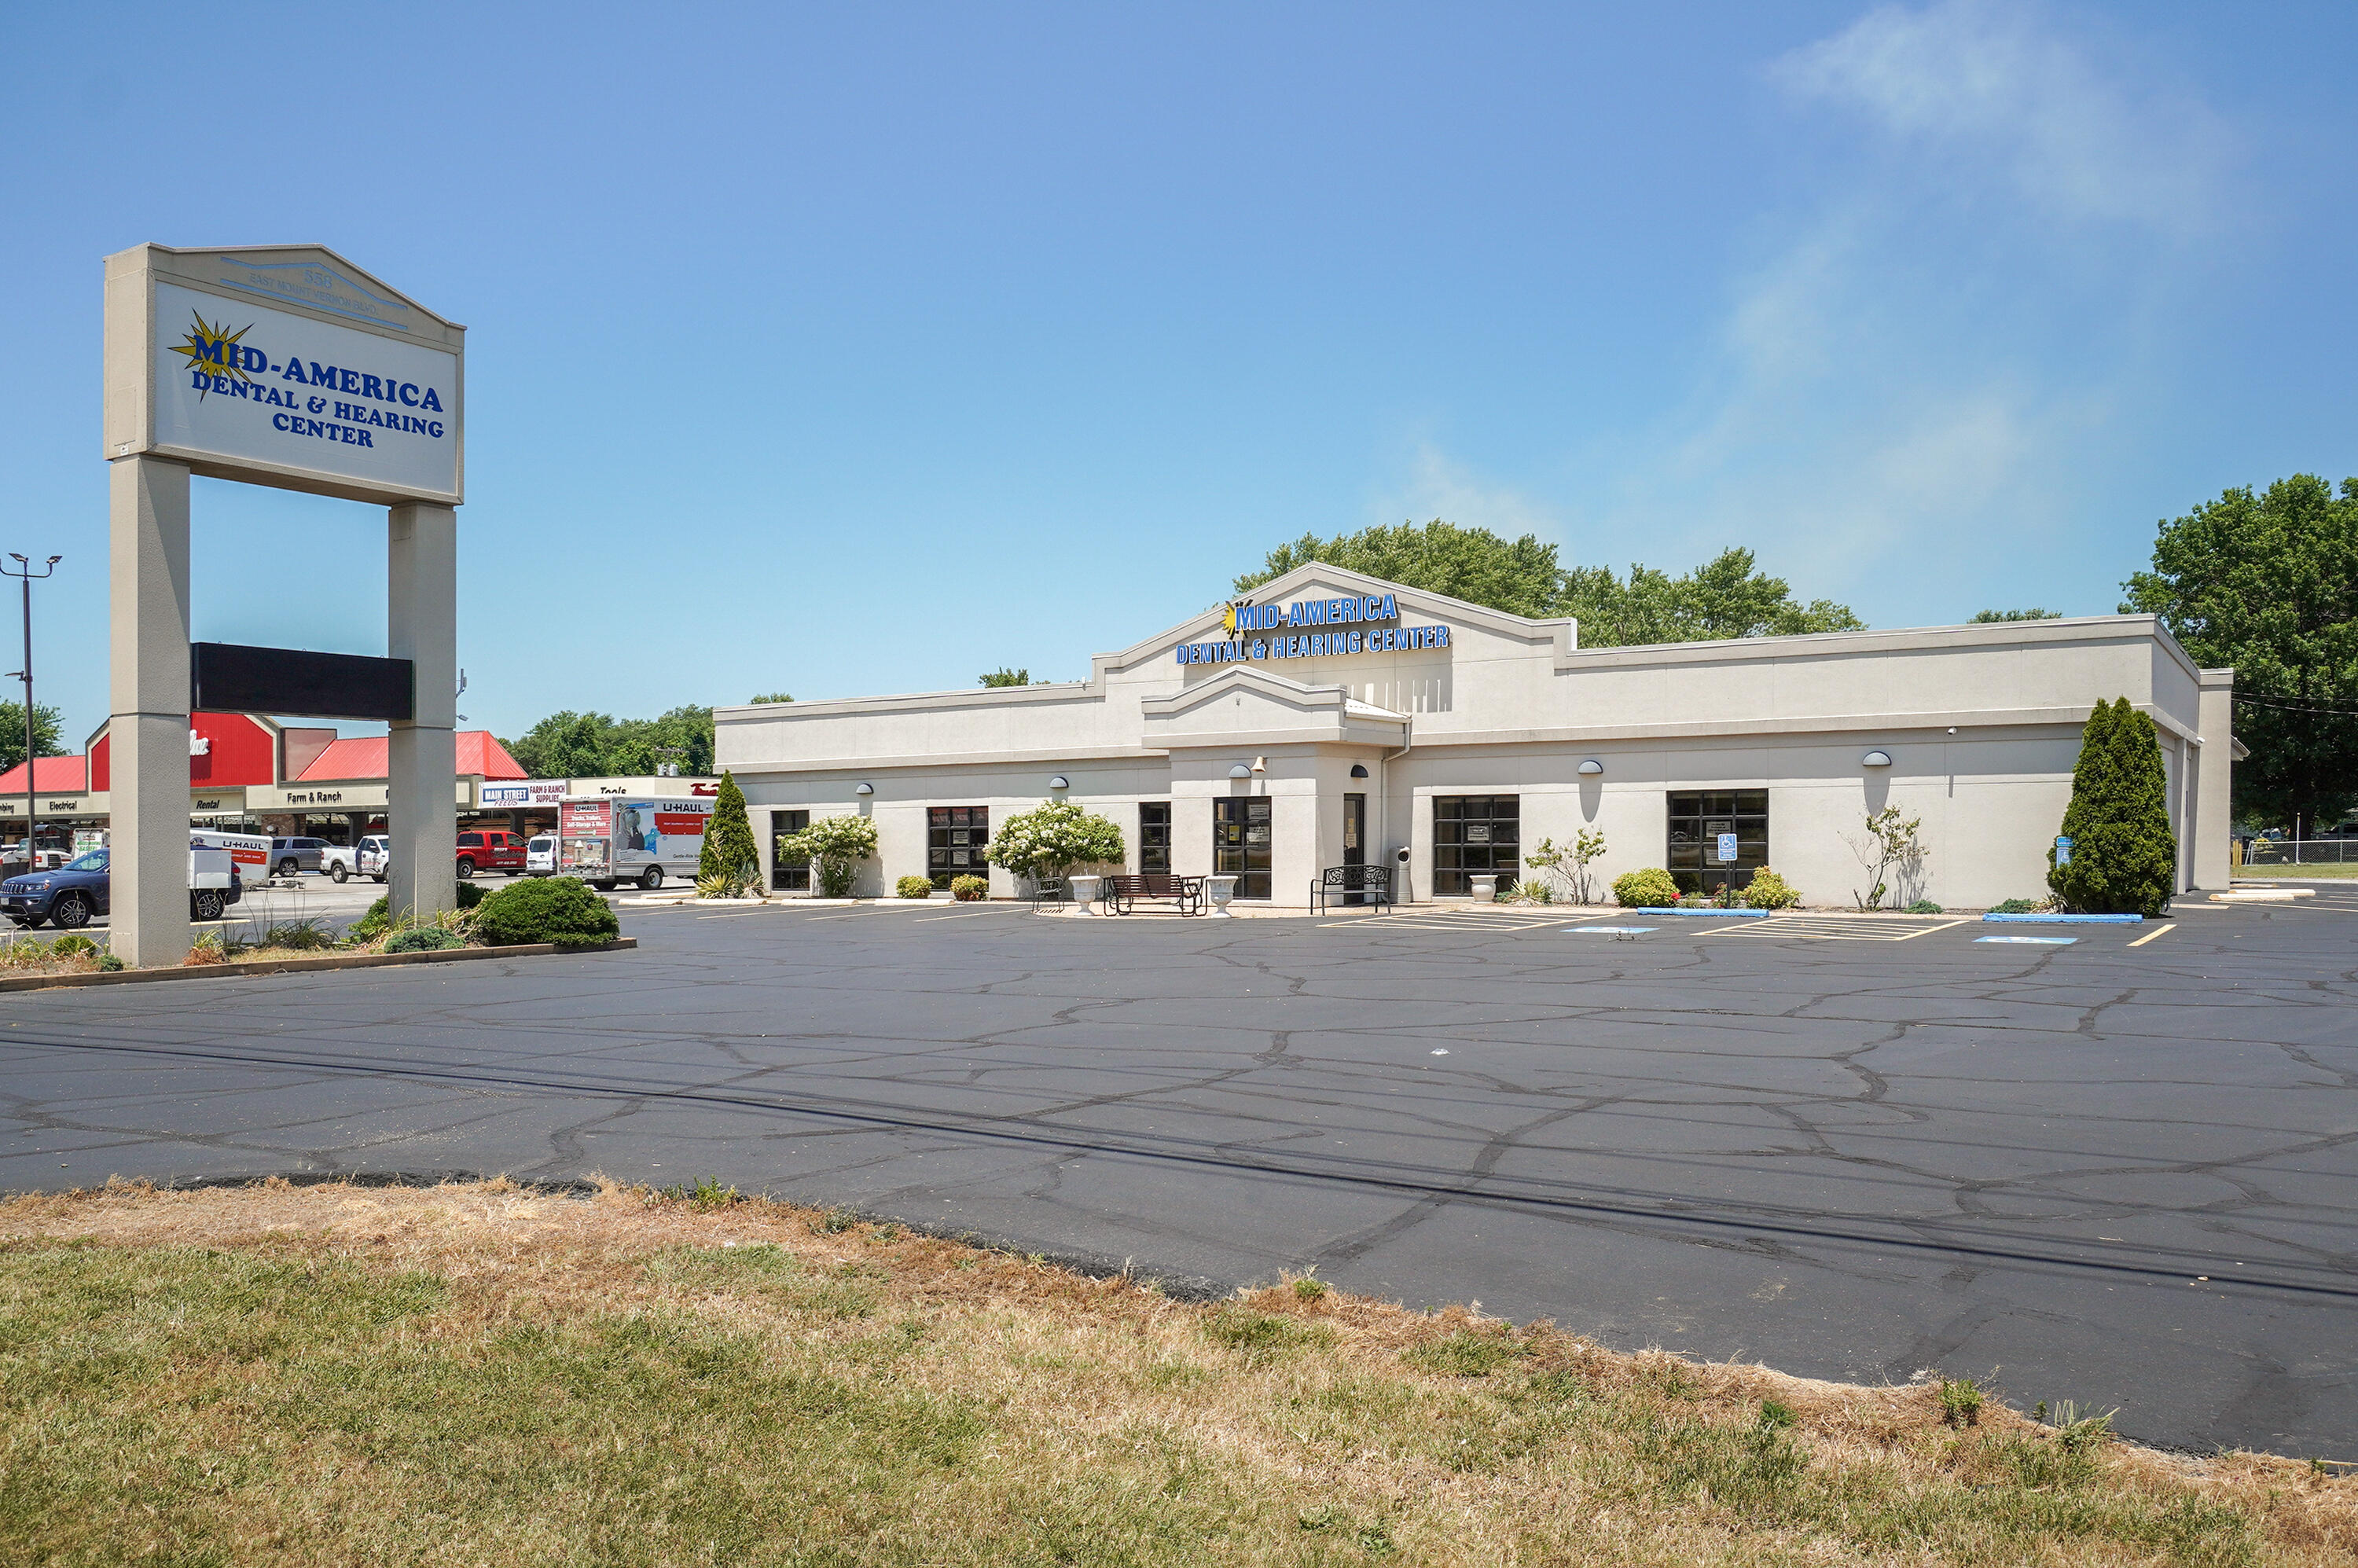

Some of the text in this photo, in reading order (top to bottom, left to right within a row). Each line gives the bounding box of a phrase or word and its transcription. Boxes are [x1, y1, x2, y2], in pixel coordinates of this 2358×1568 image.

[303, 270, 332, 289] 558
[249, 273, 274, 287] EAST
[277, 280, 310, 296] MOUNT
[314, 290, 352, 308] VERNON
[193, 336, 444, 413] MID-AMERICA
[192, 371, 445, 439] DENTAL & HEARING
[272, 413, 374, 448] CENTER
[1235, 593, 1398, 631] MID-AMERICA
[1177, 625, 1449, 665] DENTAL & HEARING CENTER
[288, 791, 342, 802] Farm & Ranch
[484, 789, 527, 800] MAIN STREET
[548, 785, 565, 794] RANCH
[50, 801, 77, 810] Electrical
[196, 799, 220, 810] Rental
[663, 803, 703, 813] U-HAUL
[223, 840, 264, 850] U-HAUL
